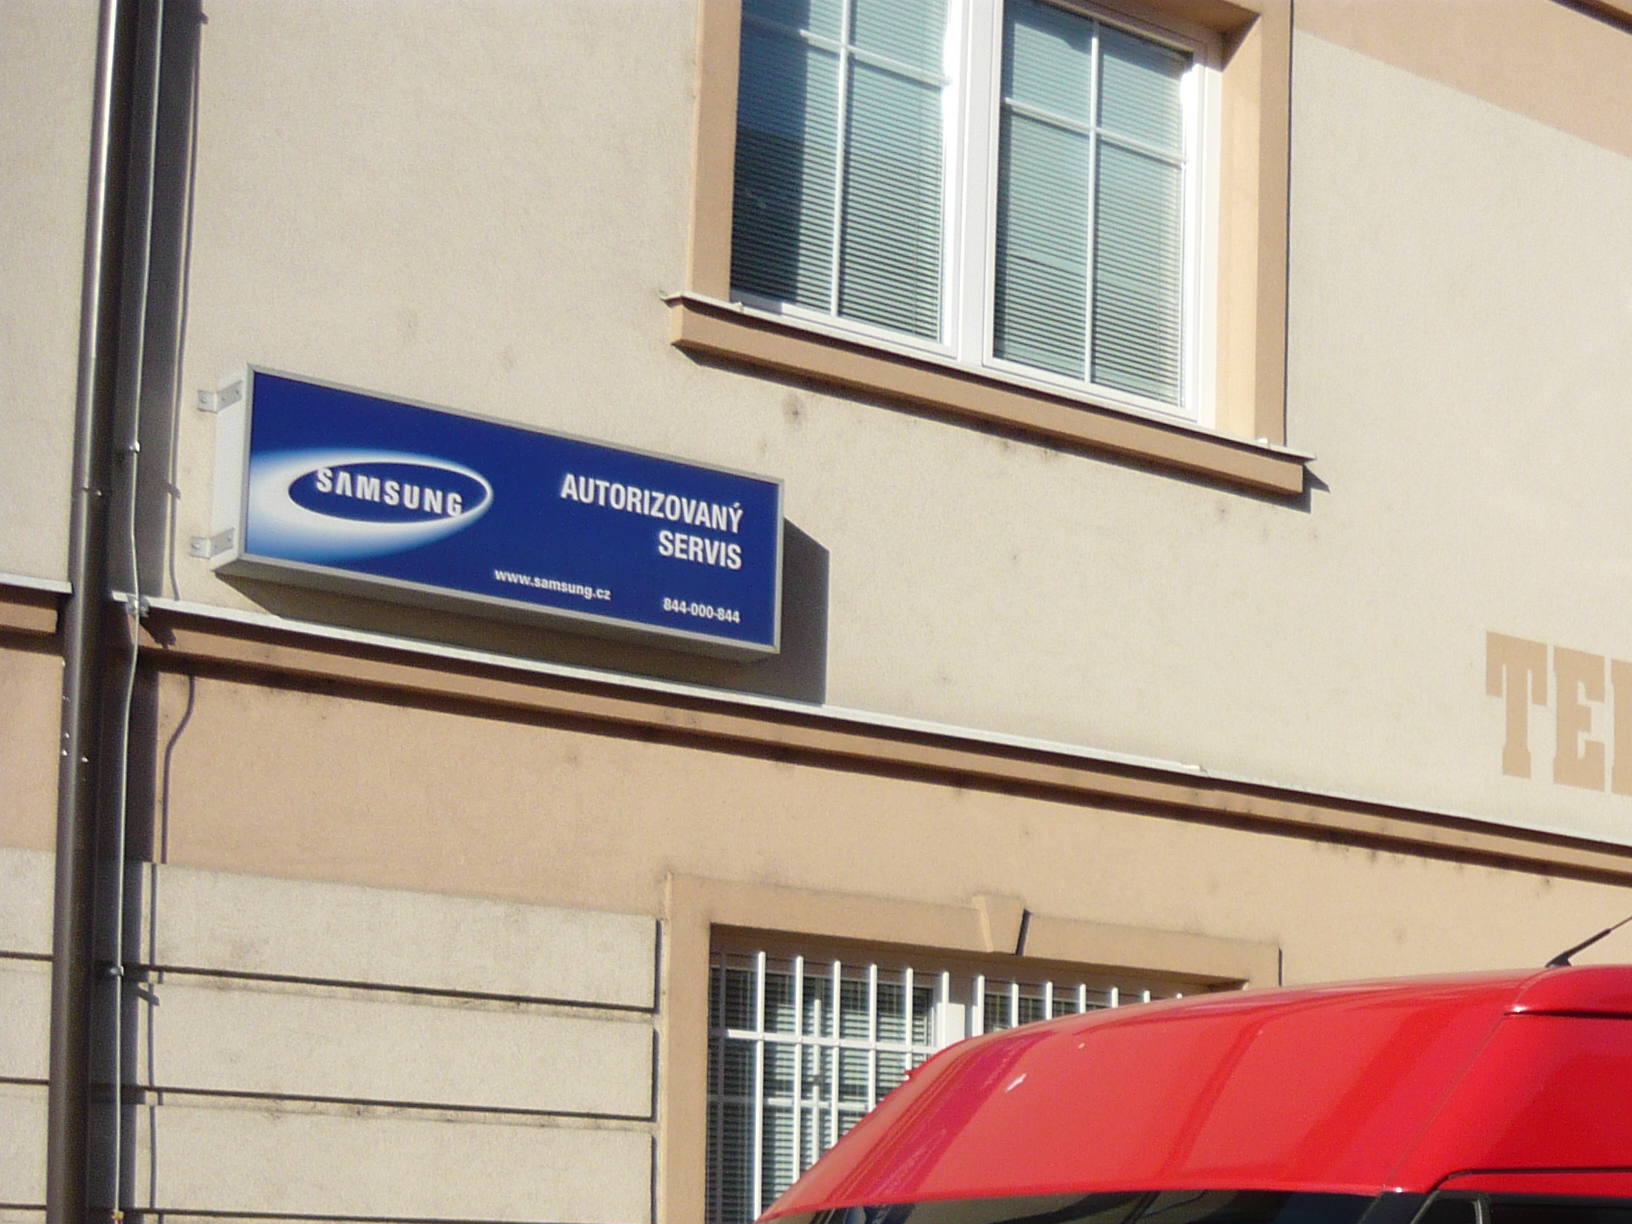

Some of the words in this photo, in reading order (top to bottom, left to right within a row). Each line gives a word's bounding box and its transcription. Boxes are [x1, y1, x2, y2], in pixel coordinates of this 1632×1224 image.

[315, 467, 463, 517] SAMSUNG
[560, 472, 743, 534] AUTORIZOVANÝ
[658, 529, 742, 570] SERVIS
[494, 569, 611, 600] www.samsung.cz
[663, 597, 740, 624] 844-000-844
